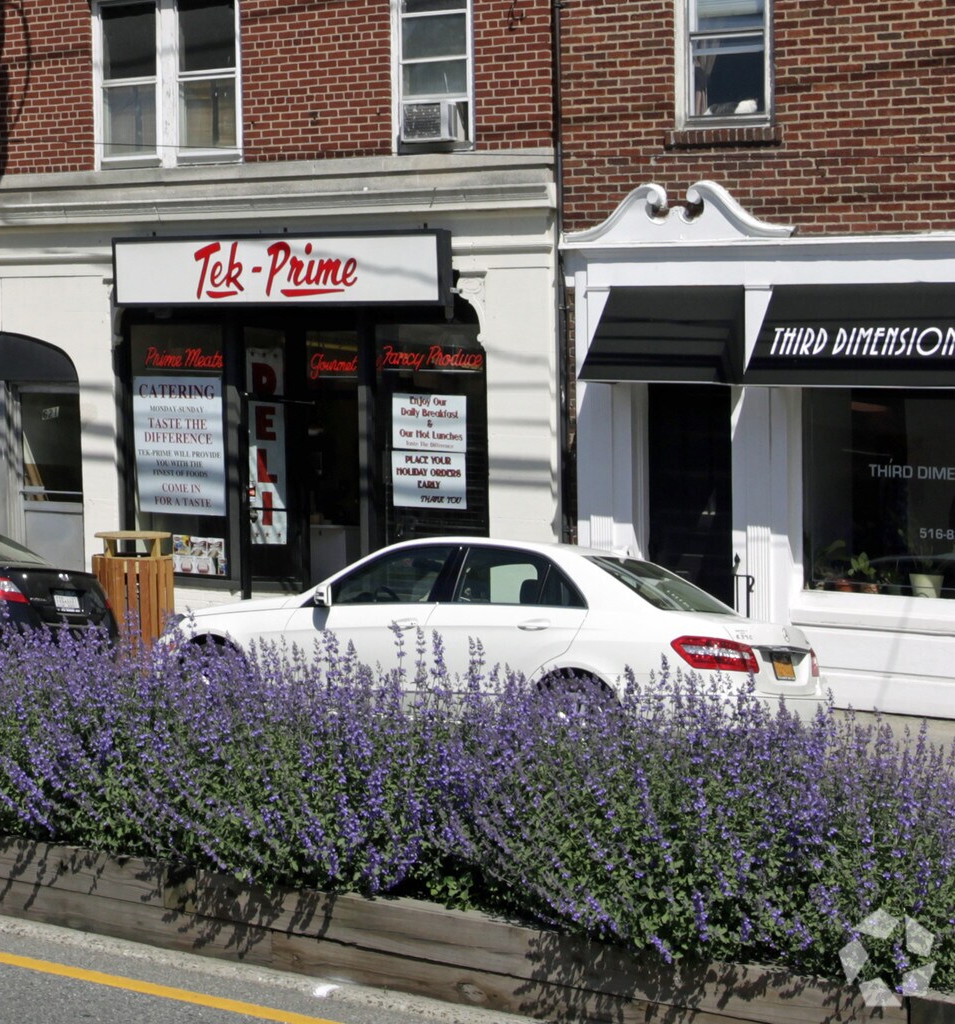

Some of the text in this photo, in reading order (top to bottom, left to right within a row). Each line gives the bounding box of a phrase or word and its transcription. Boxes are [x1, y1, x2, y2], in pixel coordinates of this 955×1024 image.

[770, 327, 955, 356] THIRD DIMENSION
[144, 346, 224, 368] Prime Meats
[382, 345, 425, 372] Fancy
[427, 345, 484, 367] Produce
[310, 353, 358, 379] Gourmet
[139, 383, 215, 400] CATERING
[409, 396, 447, 407] Enjoy Our
[401, 407, 458, 419] Daily Breakfast
[148, 417, 208, 430] TASTE THE
[427, 419, 433, 428] &
[144, 432, 213, 445] DIFFERENCE
[399, 429, 463, 442] Our Hot Lunches
[251, 362, 278, 526] DELI
[138, 449, 172, 457] TEK-PRIME
[191, 451, 222, 459] PROVIDE
[405, 455, 451, 465] PLACE YOUR
[170, 460, 188, 468] WITH
[186, 470, 208, 478] FOODS
[396, 467, 461, 477] HOLIDAY ORDERS
[869, 464, 913, 479] THIRD
[162, 483, 201, 494] COME IN
[417, 480, 440, 489] EARLY
[154, 496, 213, 508] FOR A TASTE
[446, 496, 462, 504] YOU
